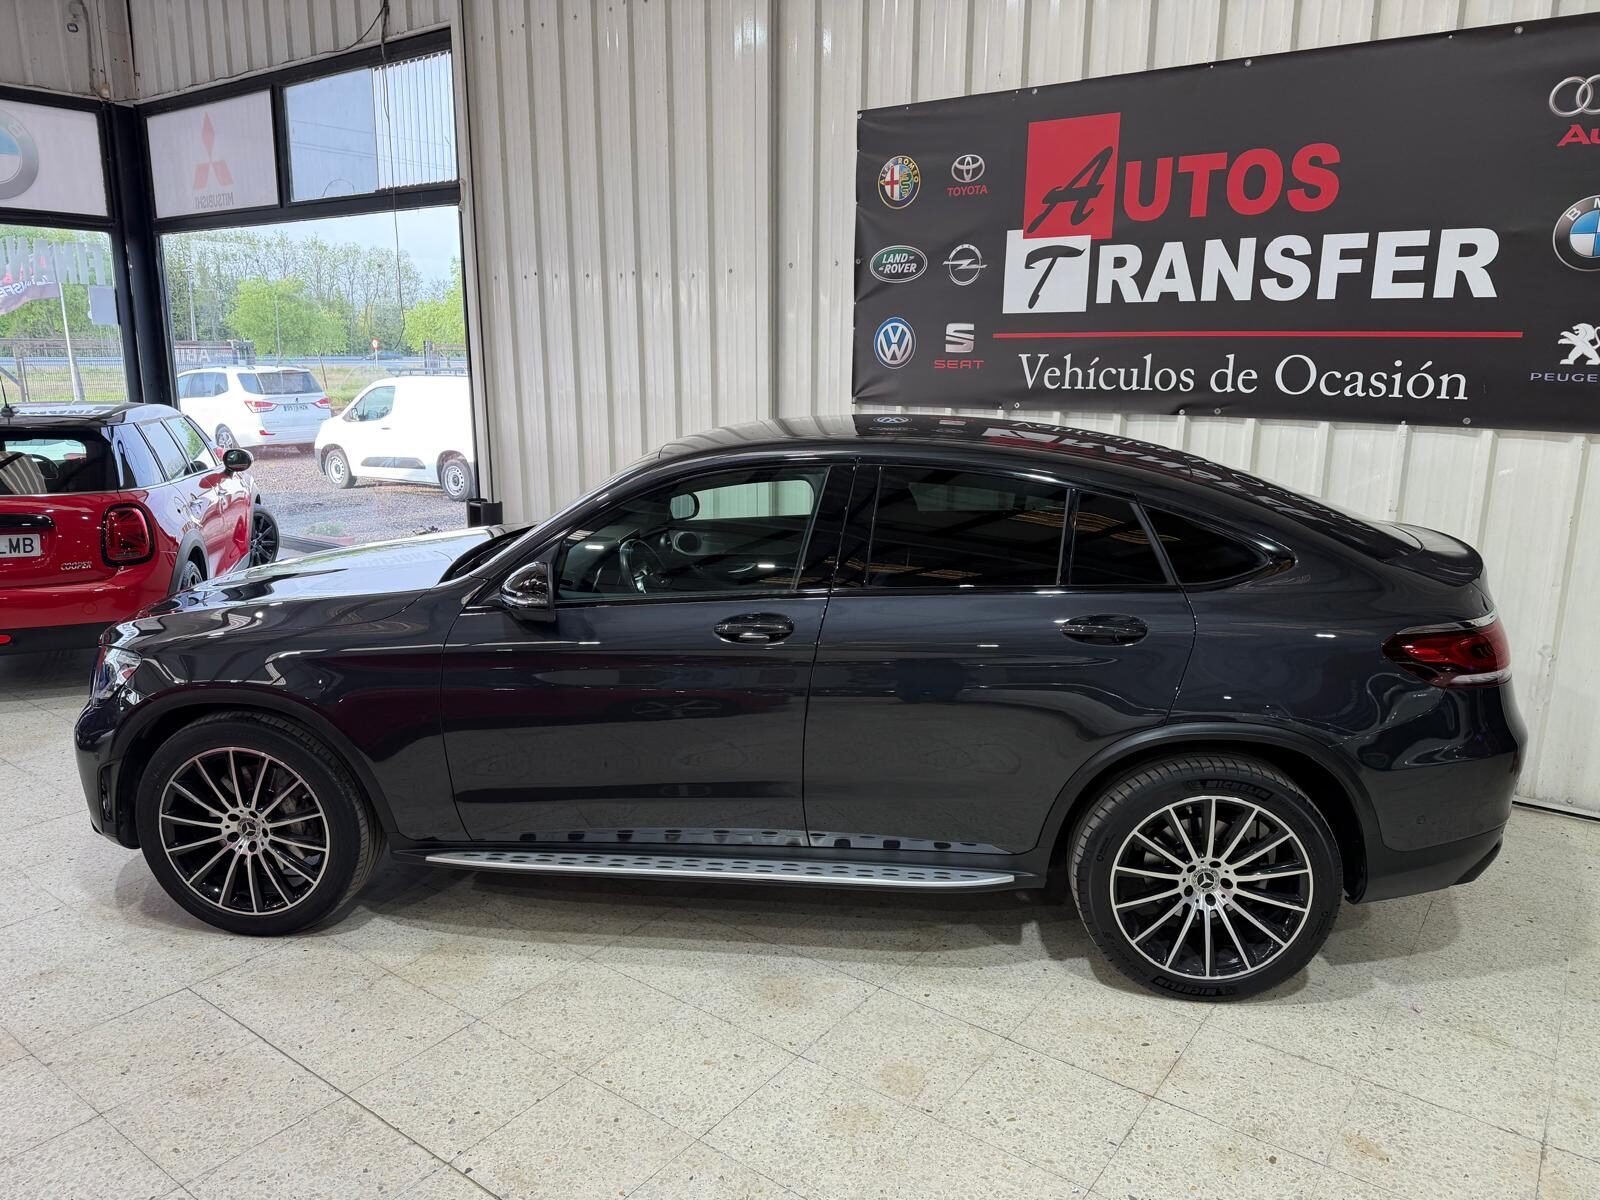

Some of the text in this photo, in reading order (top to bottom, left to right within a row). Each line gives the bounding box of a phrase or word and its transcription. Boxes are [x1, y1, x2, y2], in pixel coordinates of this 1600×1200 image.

[947, 184, 988, 197] TOYOTA
[1027, 143, 1341, 234] AUTOS
[882, 253, 909, 264] LAND
[883, 263, 917, 274] ROVER
[1025, 228, 1500, 310] TRANSFER
[934, 360, 985, 369] SEAT
[1018, 353, 1469, 400] Vehículos de Ocasión
[1530, 372, 1599, 383] PEUGE
[60, 561, 93, 571] COOPER
